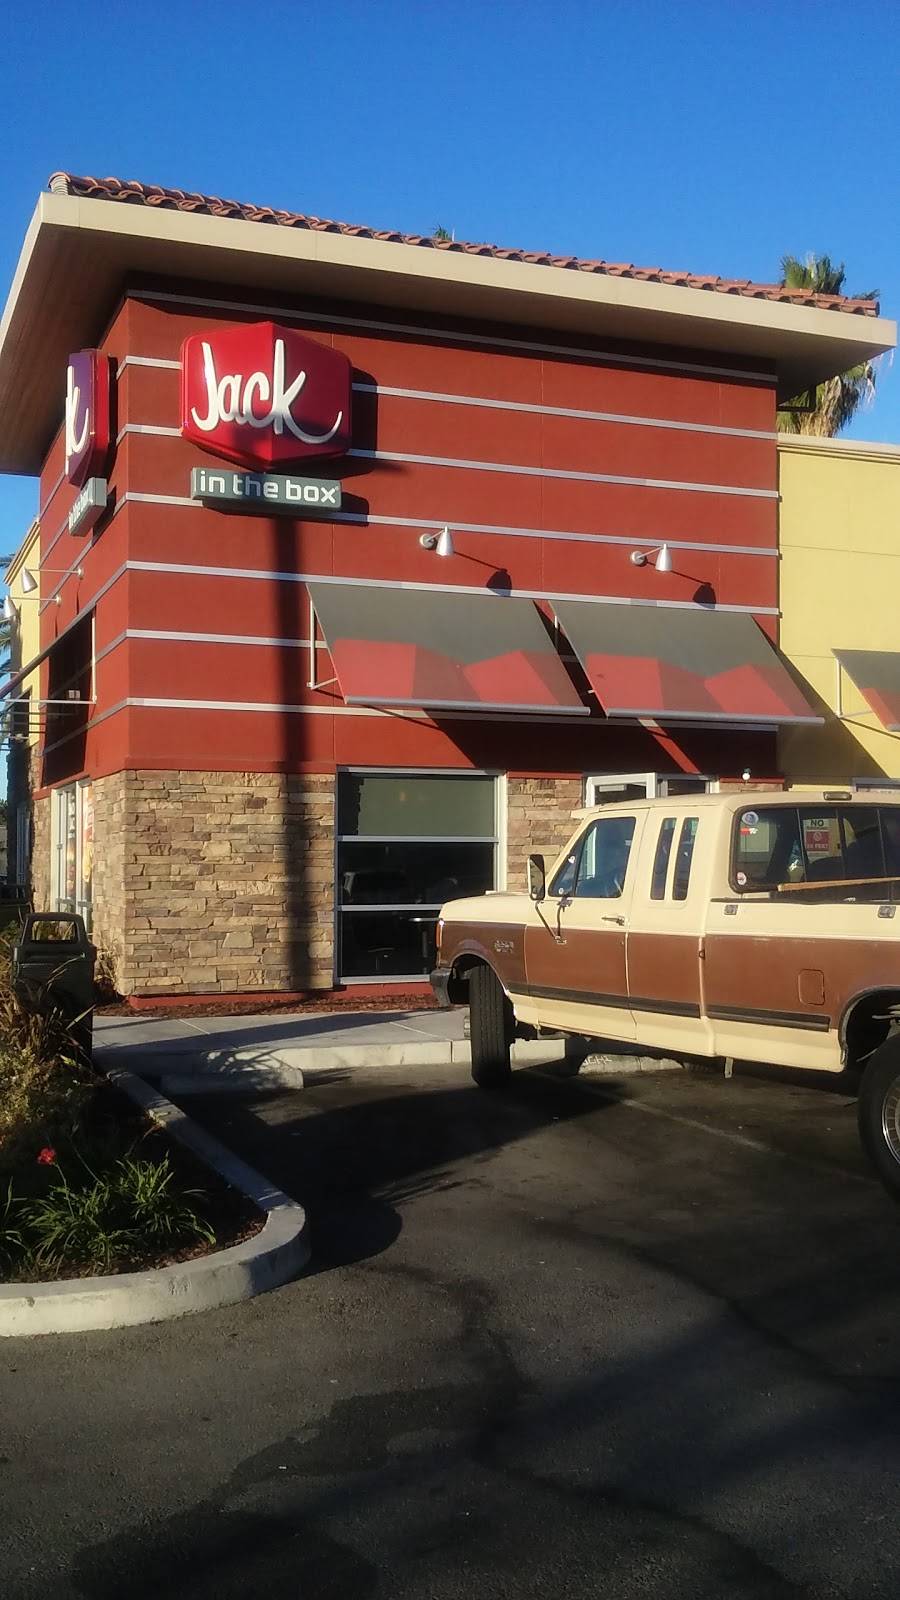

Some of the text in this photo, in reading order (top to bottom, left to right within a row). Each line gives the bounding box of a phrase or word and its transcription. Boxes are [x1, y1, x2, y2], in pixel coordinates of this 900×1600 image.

[191, 339, 343, 444] Jack
[200, 470, 336, 504] in the box
[810, 819, 824, 827] NO
